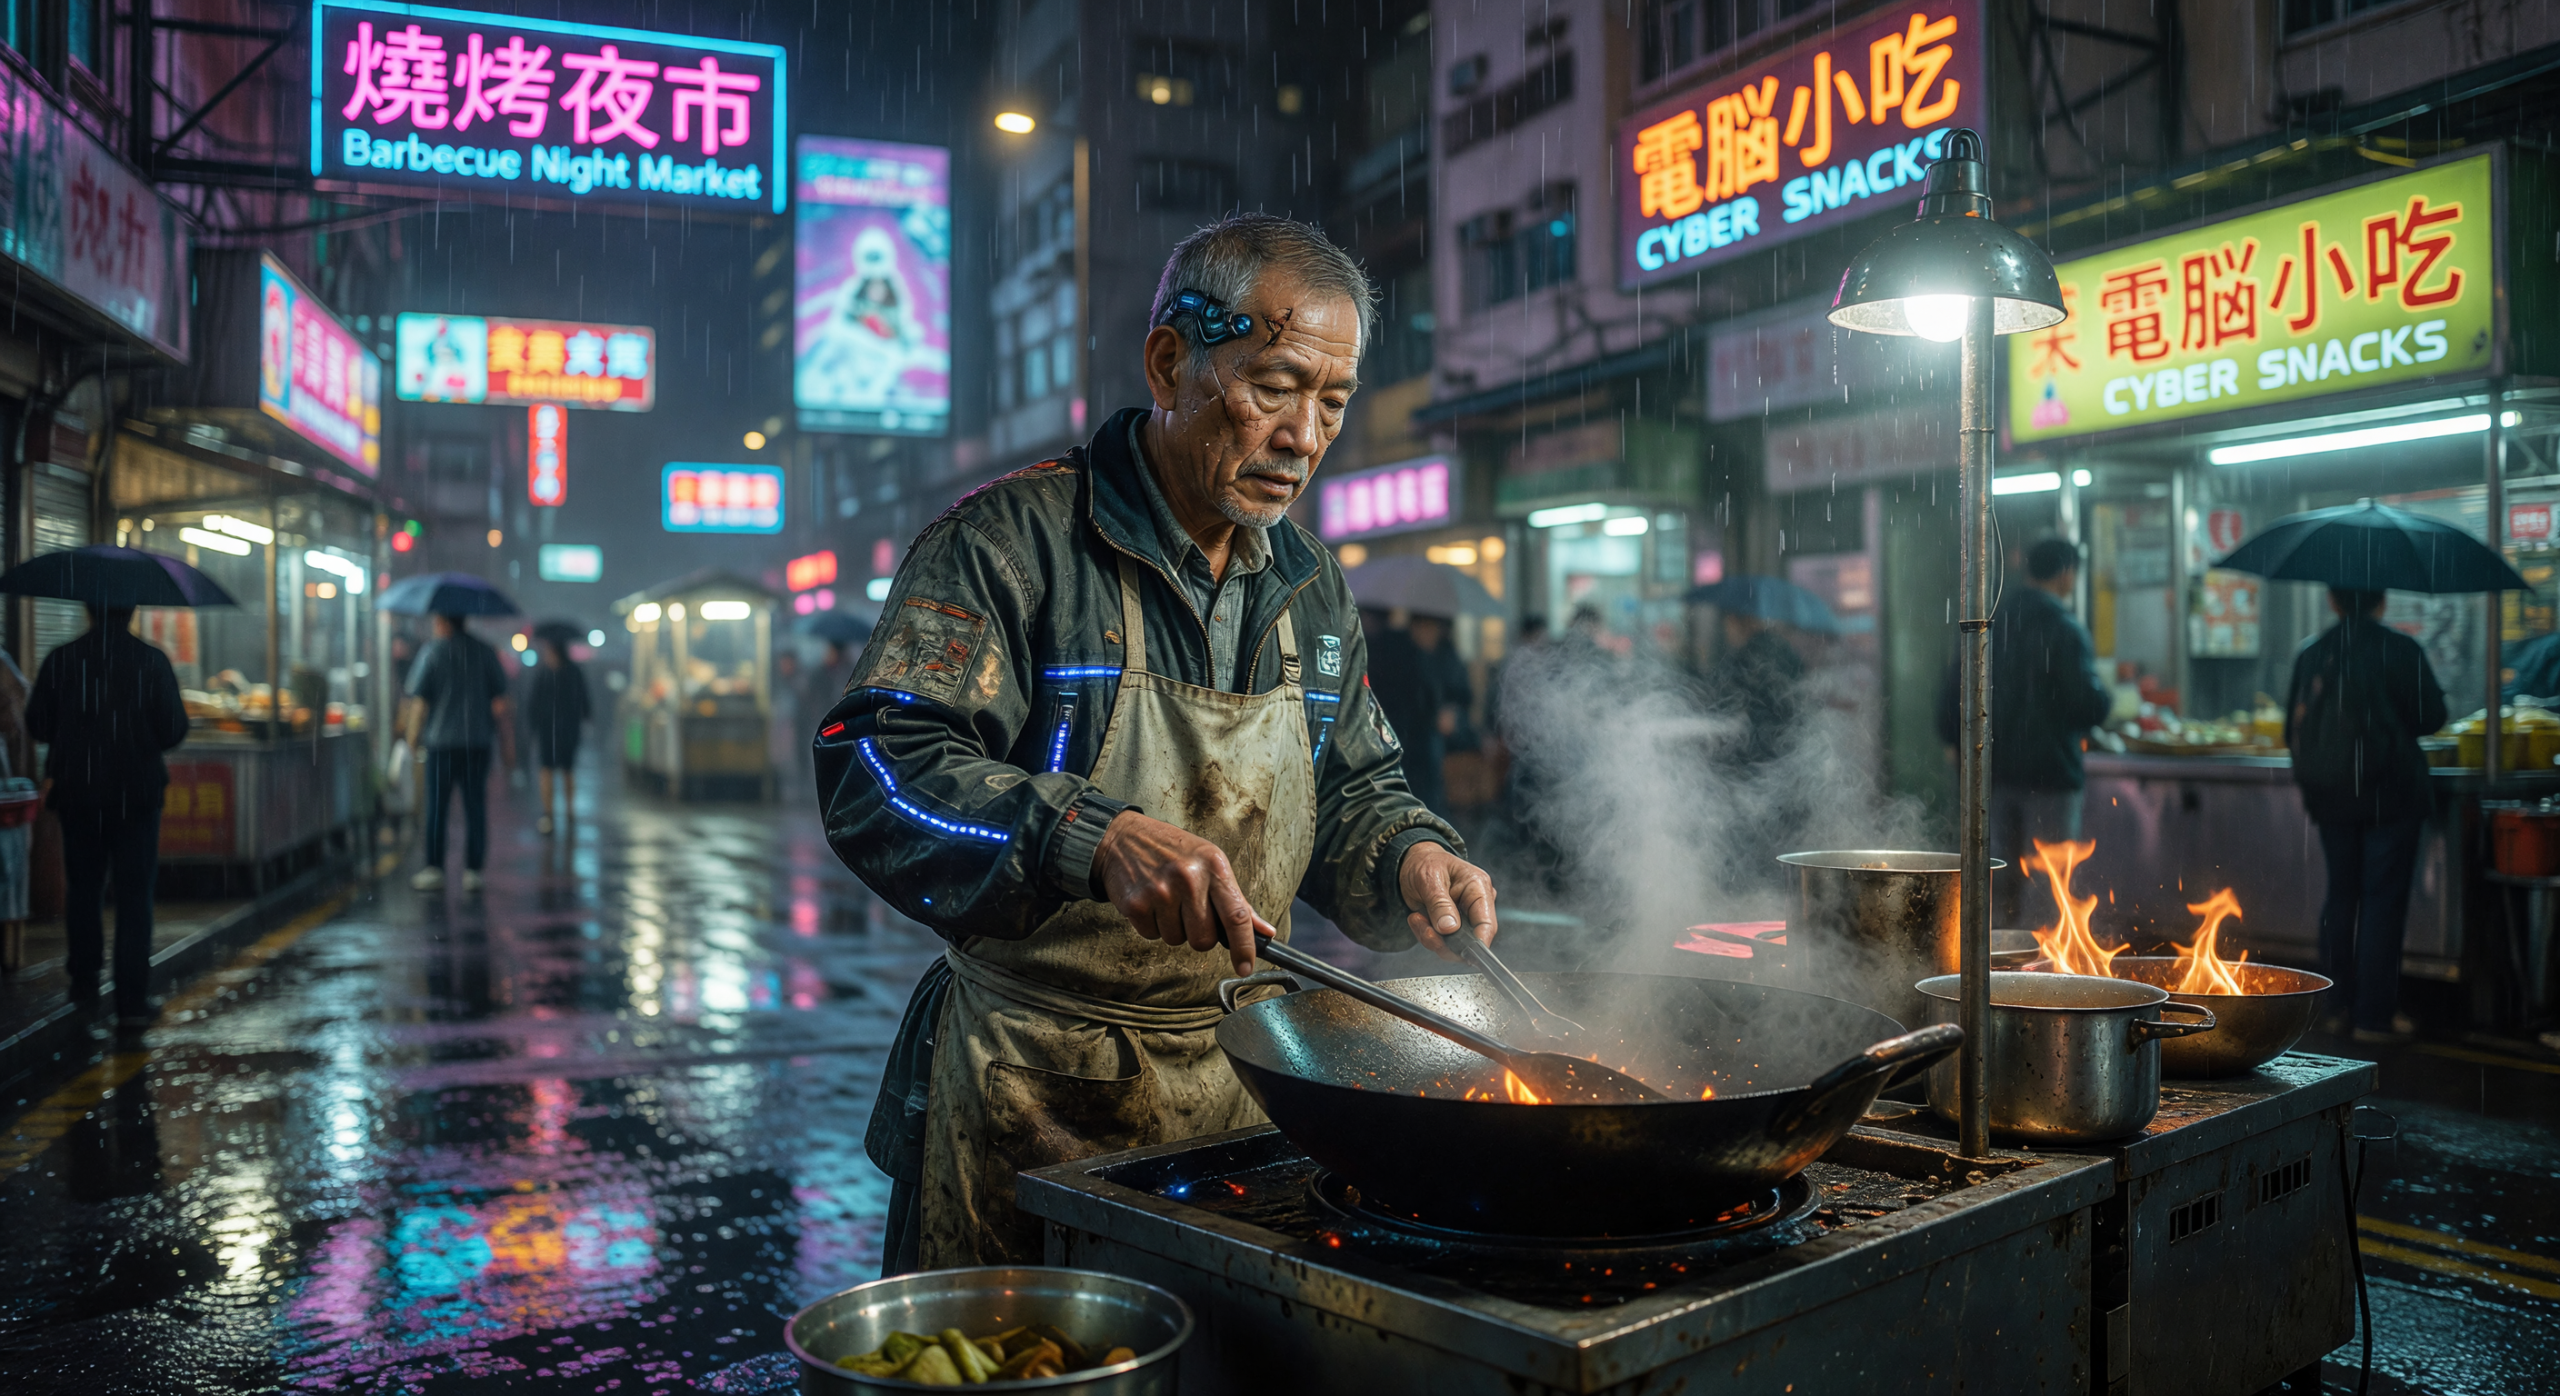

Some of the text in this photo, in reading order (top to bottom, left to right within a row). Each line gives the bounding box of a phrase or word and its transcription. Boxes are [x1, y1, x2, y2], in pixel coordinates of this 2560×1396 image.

[342, 21, 761, 156] 燒烤夜市
[1634, 13, 1961, 220] 電腦小吃
[343, 128, 522, 181] Barbecue
[531, 144, 631, 195] Night
[639, 153, 763, 200] Market
[1636, 196, 1760, 271] CYBER
[2101, 196, 2464, 364] 電腦小吃
[2103, 319, 2449, 415] CYBER SNACKS
